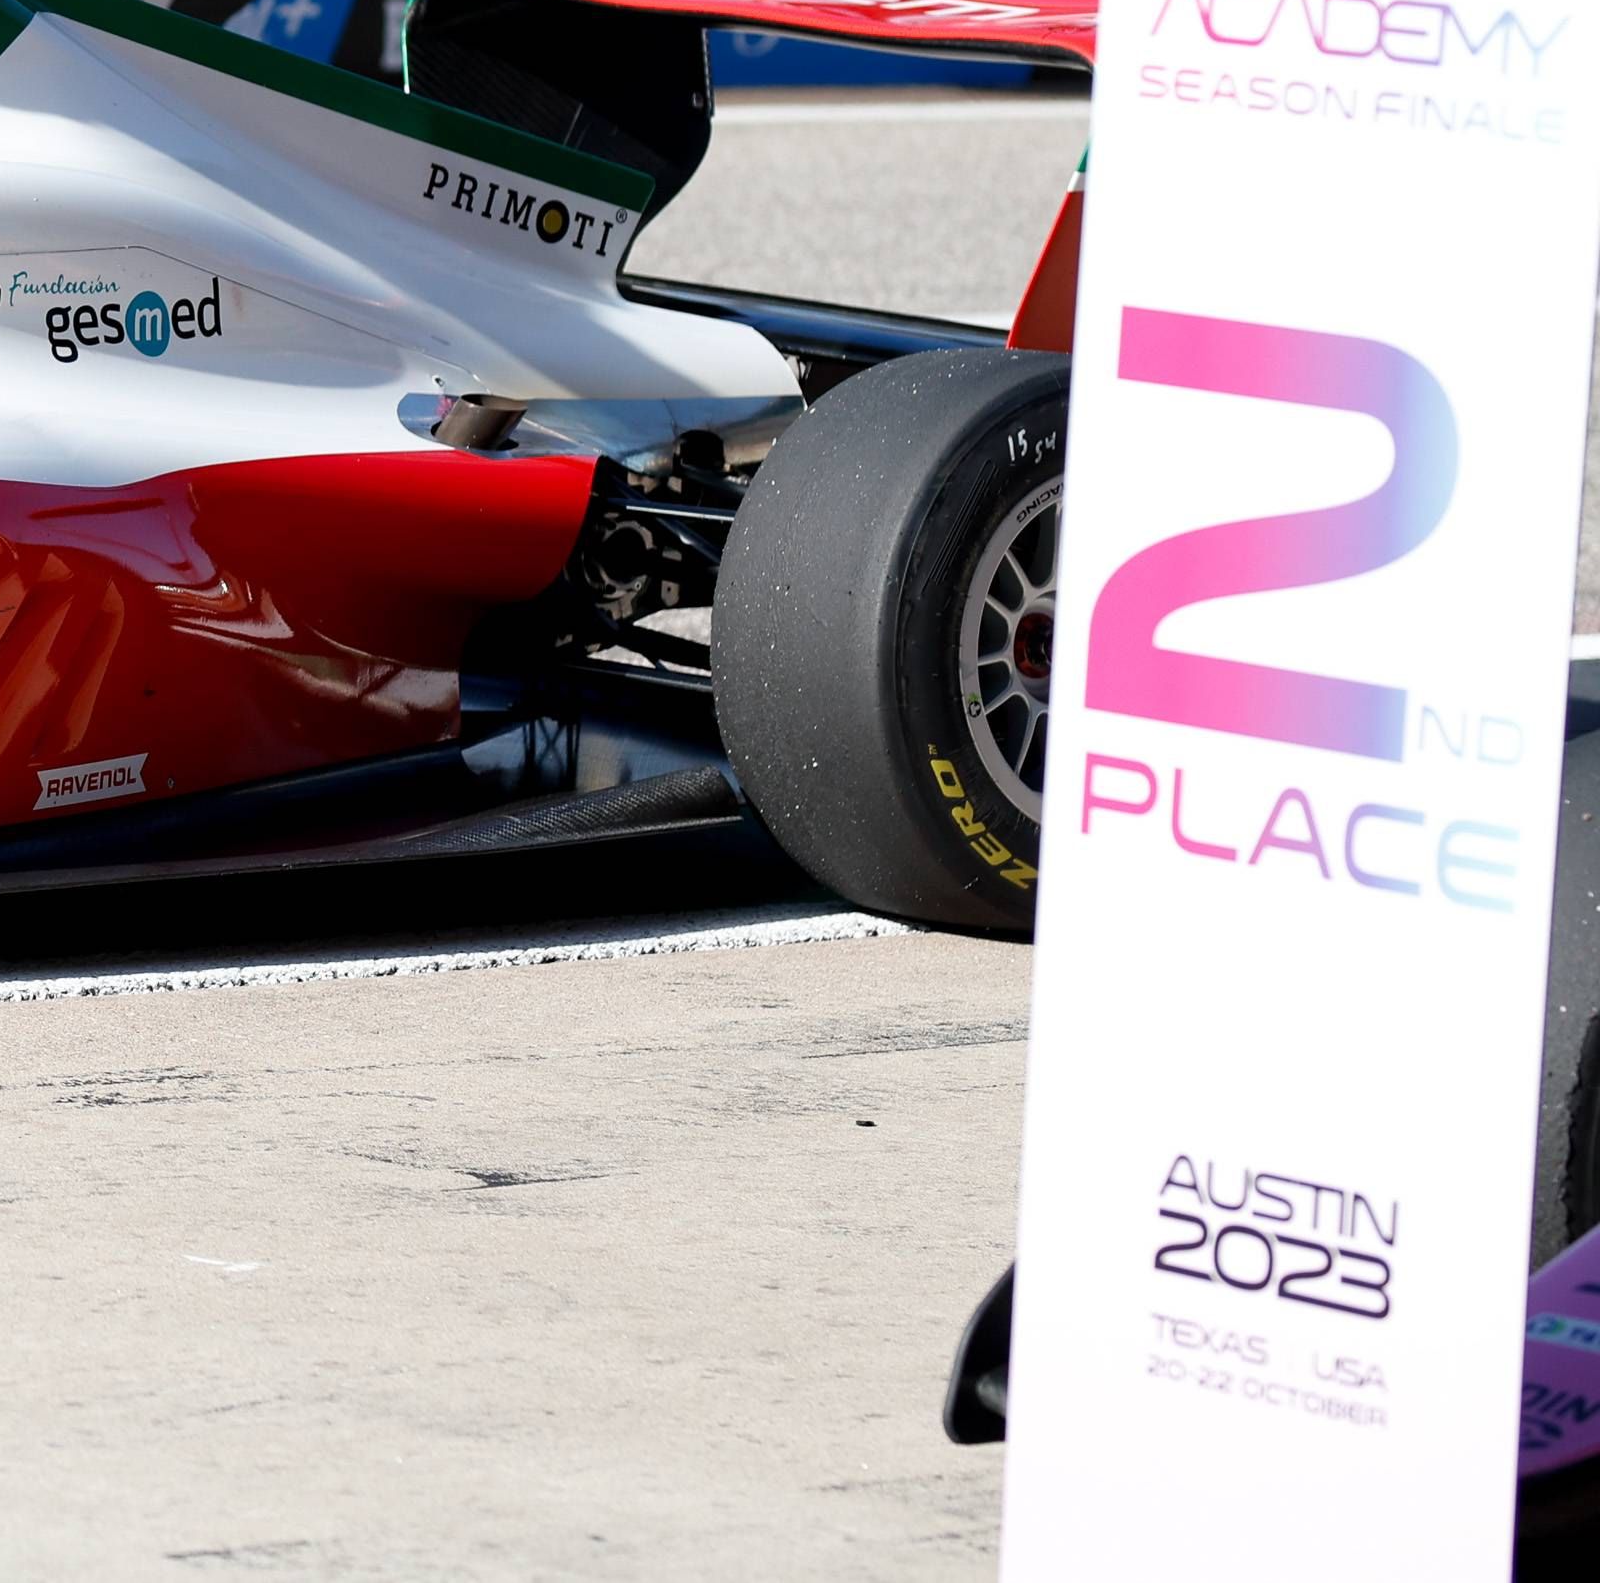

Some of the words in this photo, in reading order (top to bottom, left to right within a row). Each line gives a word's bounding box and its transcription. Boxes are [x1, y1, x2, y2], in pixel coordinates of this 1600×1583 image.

[1139, 63, 1357, 120] SEASON
[1374, 89, 1566, 145] FINALE
[7, 271, 122, 308] Fundación
[46, 275, 224, 363] gesmed
[1007, 429, 1028, 462] 15
[1016, 479, 1064, 523] ACING
[46, 765, 138, 799] RAVENOL
[1080, 751, 1521, 914] PLACE
[1158, 1154, 1399, 1247] AUSTIN
[1154, 1208, 1392, 1320] 2023
[1146, 1352, 1234, 1395] 20-22
[1242, 1379, 1389, 1429] OCTOBER
[1149, 1311, 1271, 1366] TEXAS
[1311, 1348, 1389, 1394] USA
